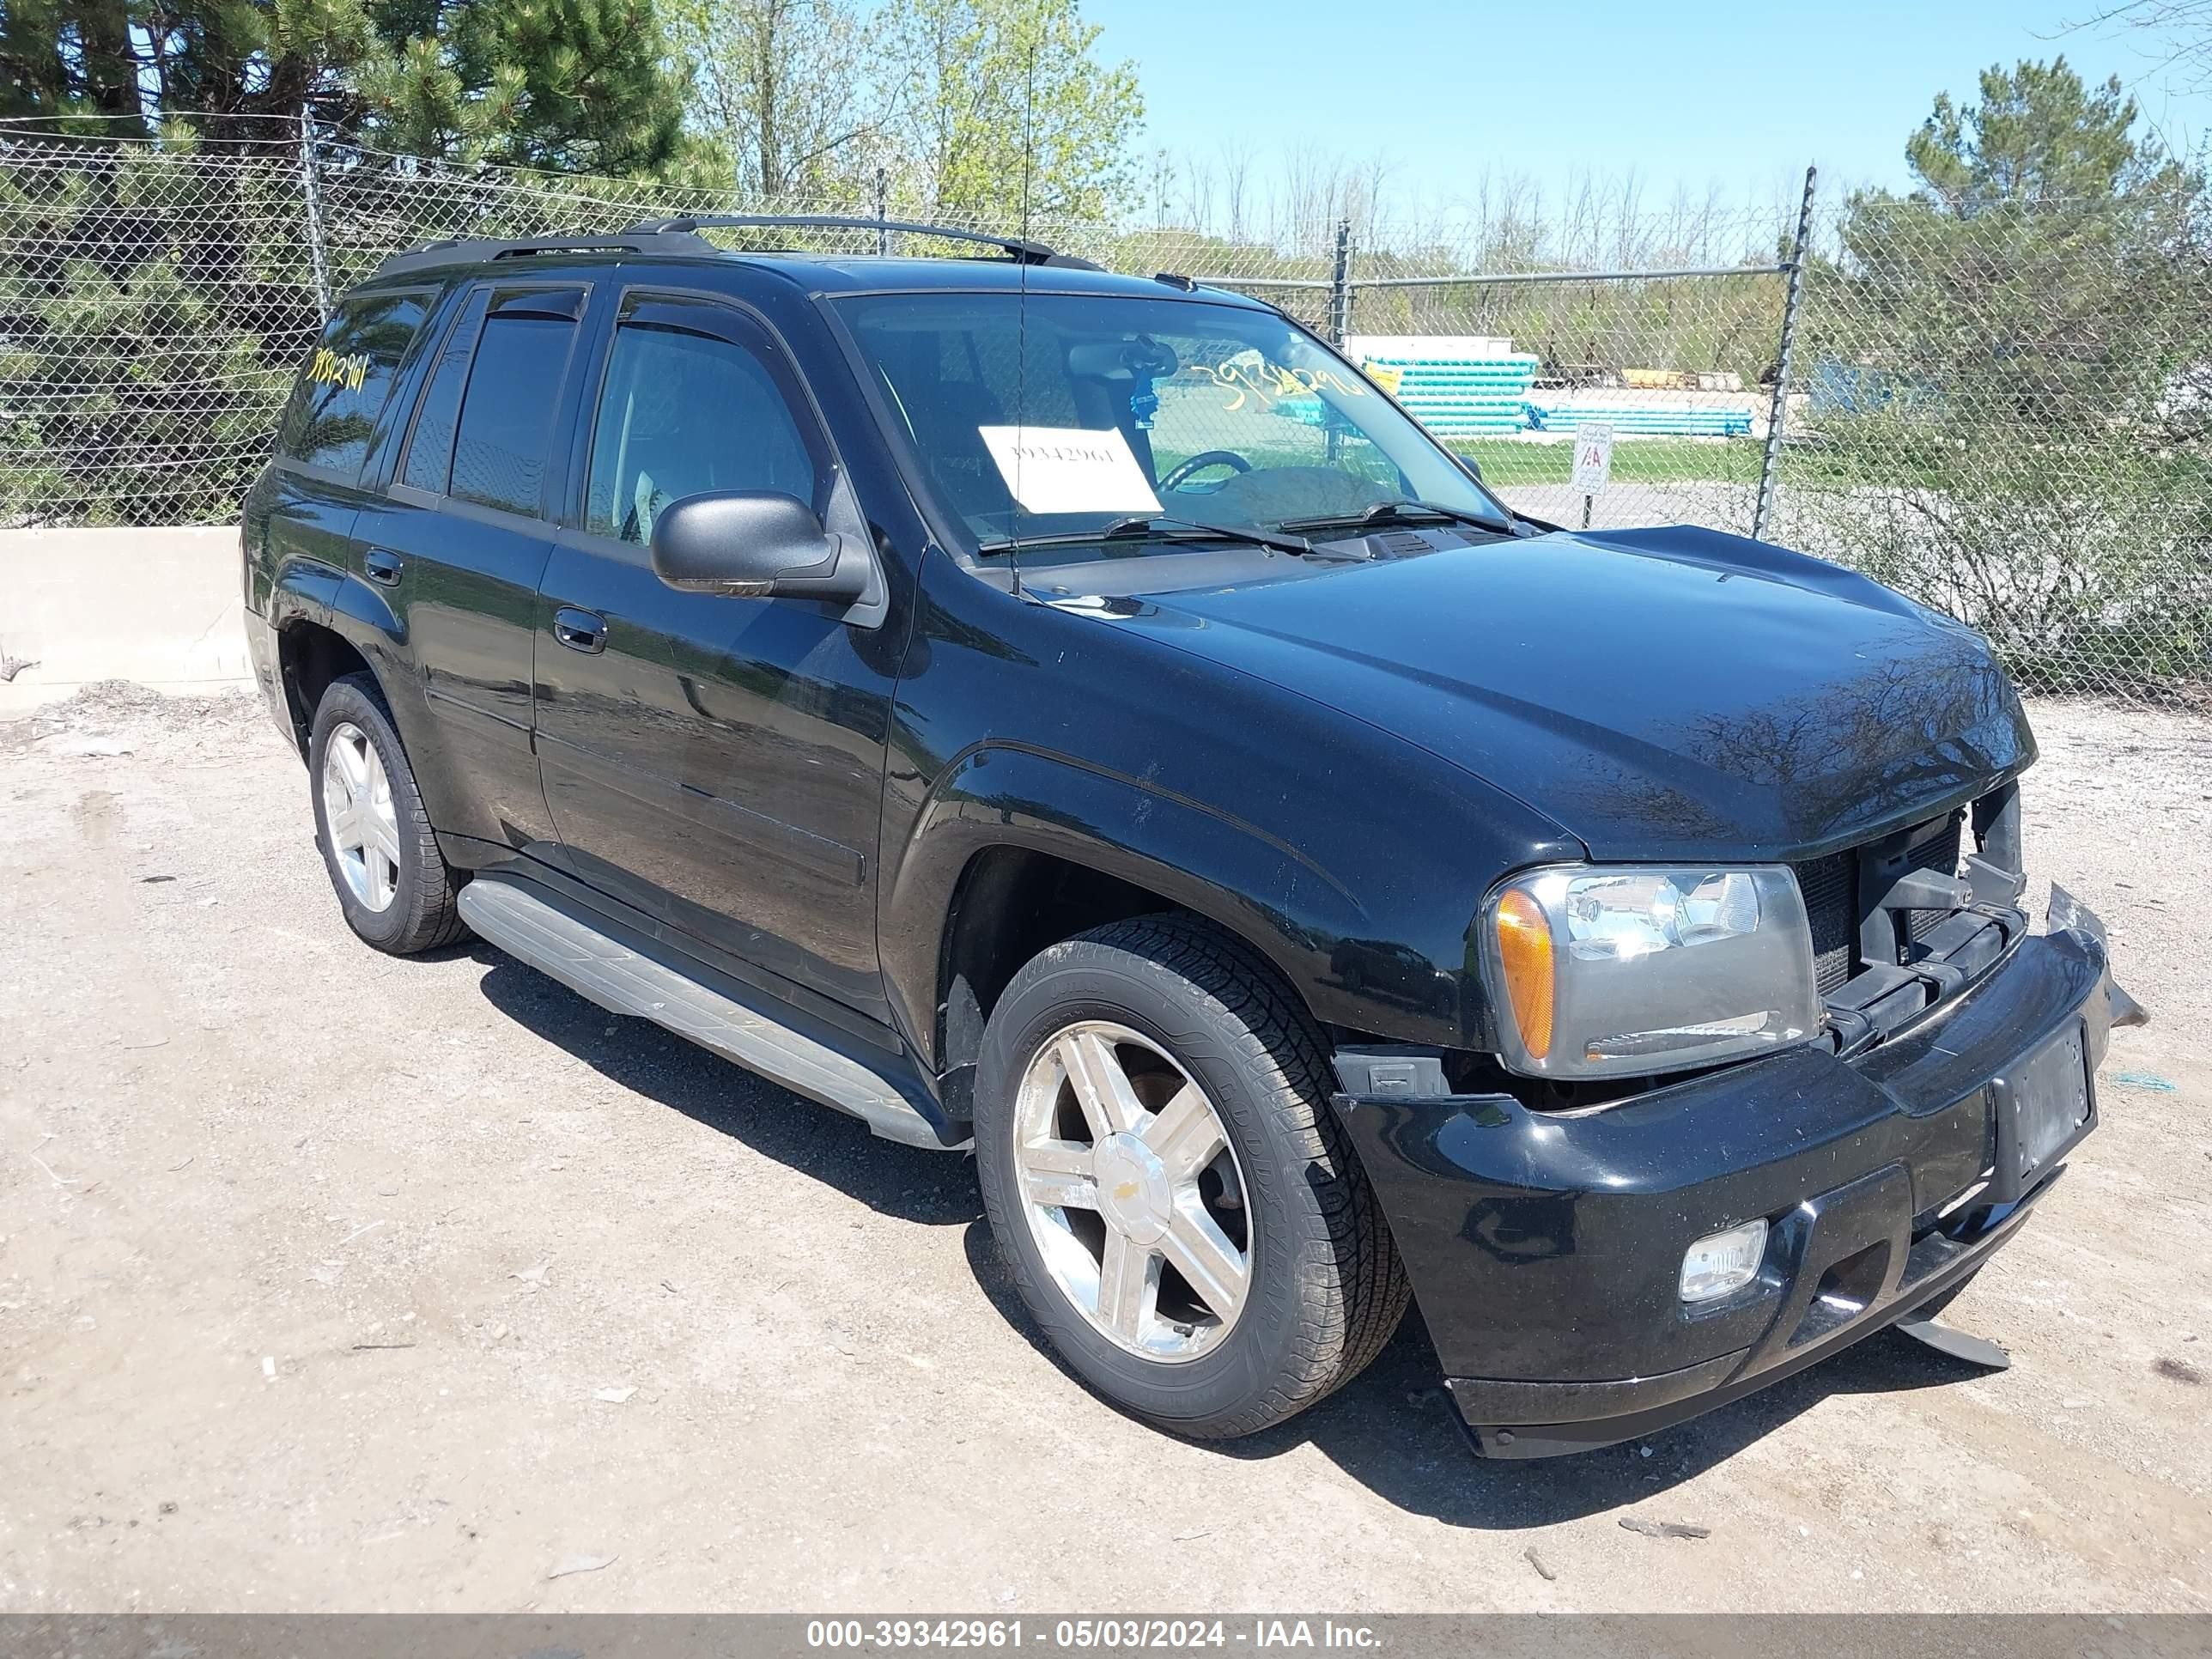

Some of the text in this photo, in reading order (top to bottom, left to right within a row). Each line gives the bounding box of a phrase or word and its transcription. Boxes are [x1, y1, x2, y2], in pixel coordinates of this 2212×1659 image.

[305, 347, 370, 396] 39342961
[1010, 446, 1114, 464] 39342961
[1215, 1073, 1289, 1334] GOODYEAR
